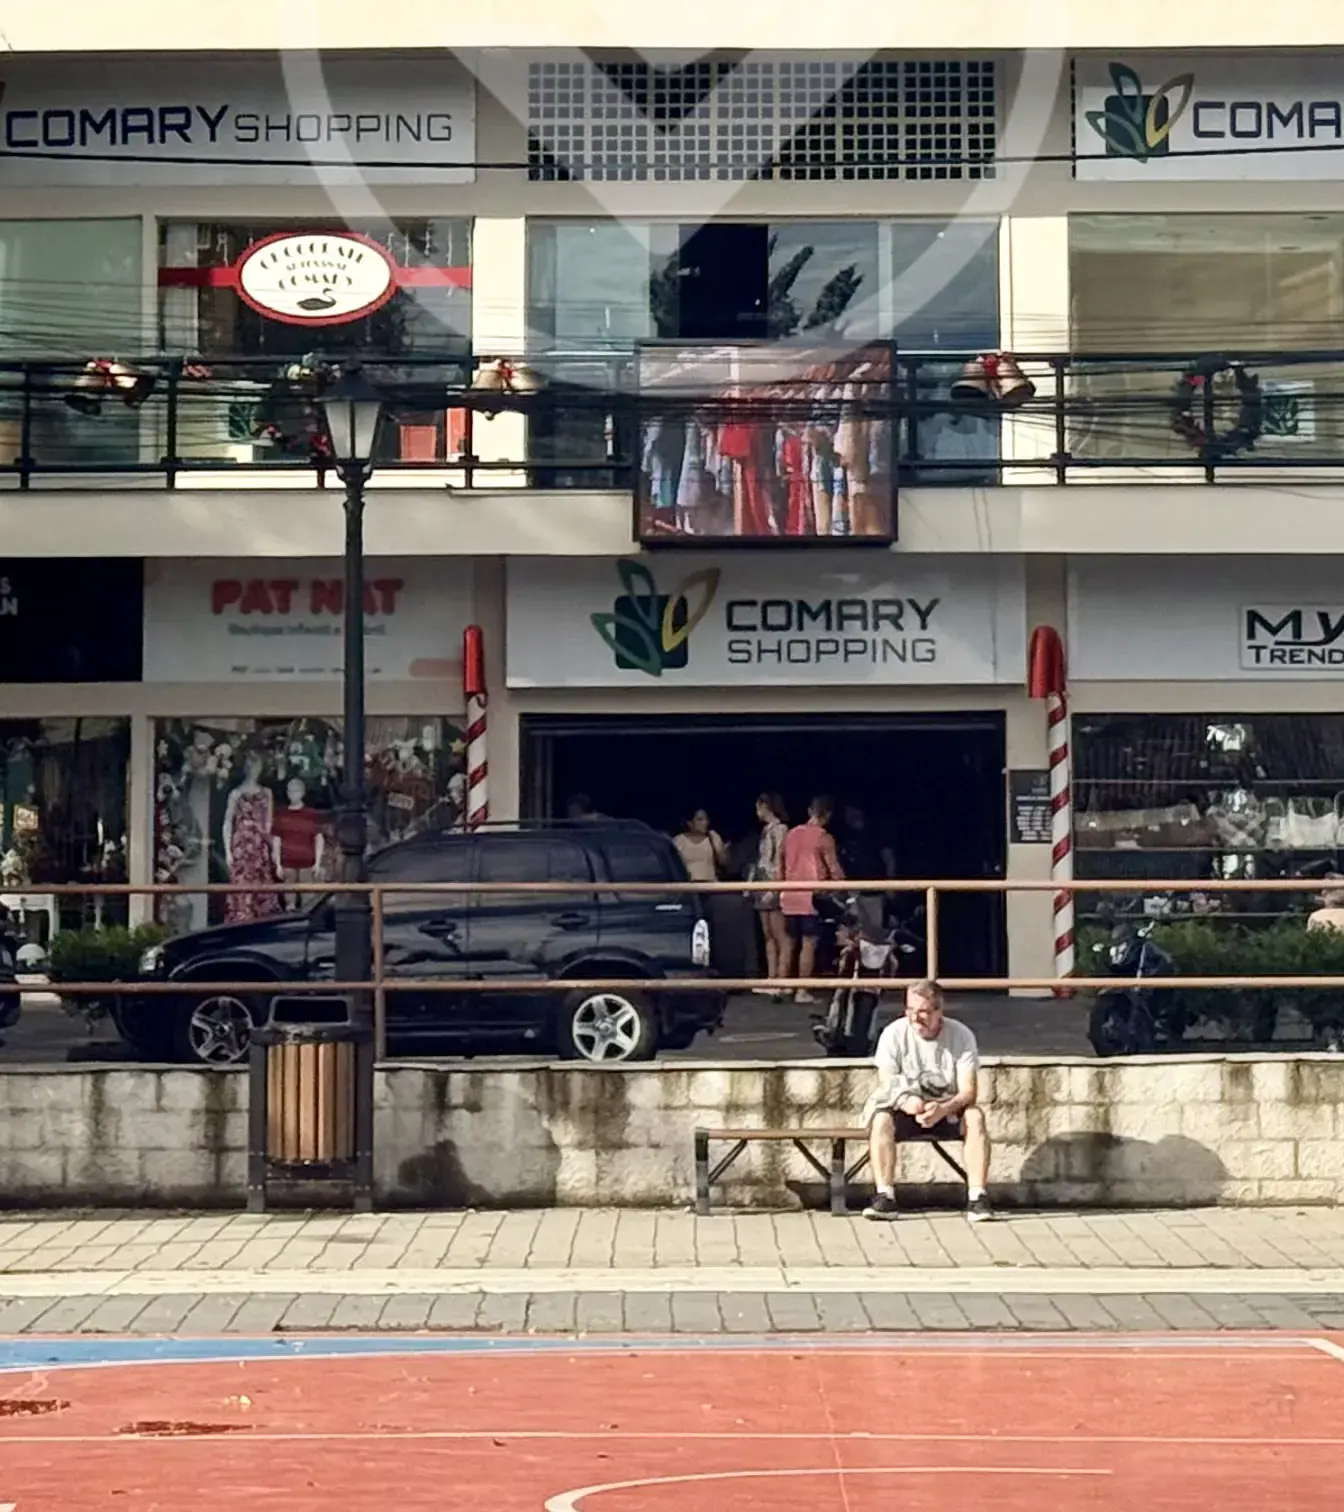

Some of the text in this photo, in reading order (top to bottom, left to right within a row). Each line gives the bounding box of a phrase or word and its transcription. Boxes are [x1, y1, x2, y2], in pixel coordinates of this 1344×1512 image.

[6, 105, 453, 148] COMARY SHOPPING
[212, 579, 299, 615] PAT
[725, 597, 941, 633] COMARY
[727, 638, 936, 664] SHOPPING
